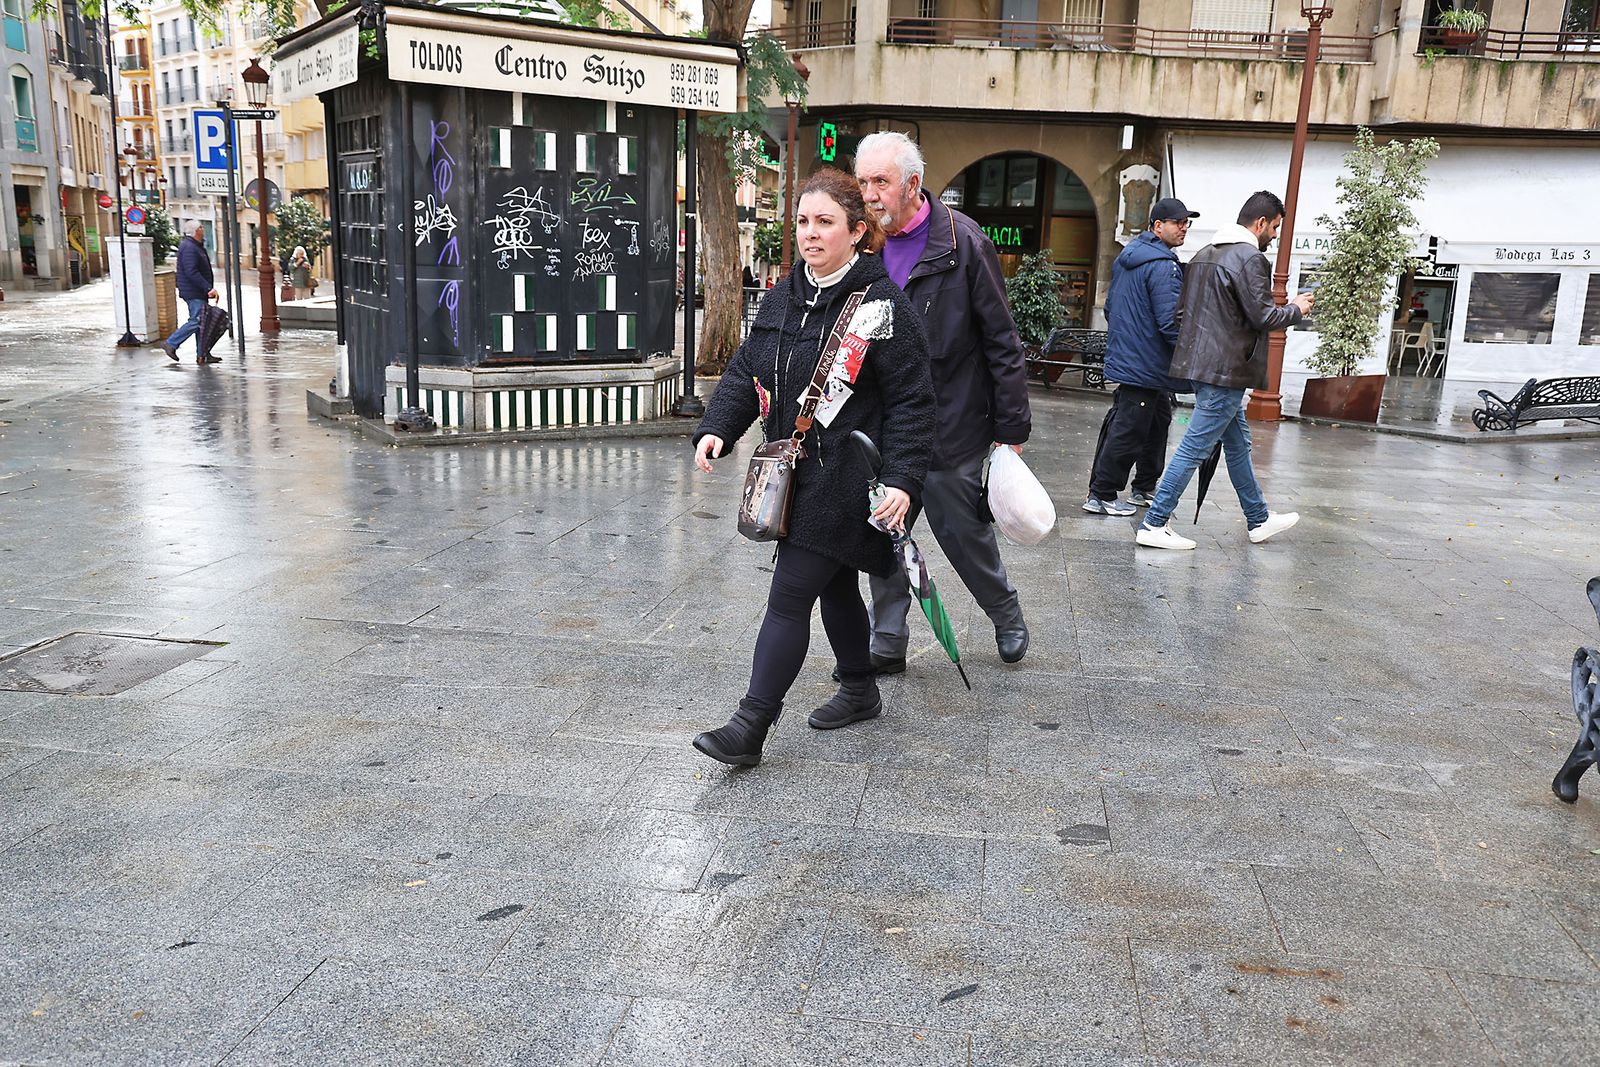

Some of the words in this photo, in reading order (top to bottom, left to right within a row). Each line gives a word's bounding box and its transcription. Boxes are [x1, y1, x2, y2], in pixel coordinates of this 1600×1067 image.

[410, 40, 462, 74] TOLDOS
[494, 44, 567, 81] Centro
[670, 63, 685, 81] 959
[687, 65, 701, 83] 281
[704, 67, 719, 85] 869
[671, 86, 685, 104] 959
[688, 88, 702, 106] 254
[705, 90, 719, 108] 142
[198, 115, 226, 162] P
[201, 177, 216, 188] CASA
[1295, 238, 1310, 249] LA
[1496, 247, 1541, 262] Bodega
[1550, 247, 1575, 261] Las
[1582, 248, 1591, 261] 3
